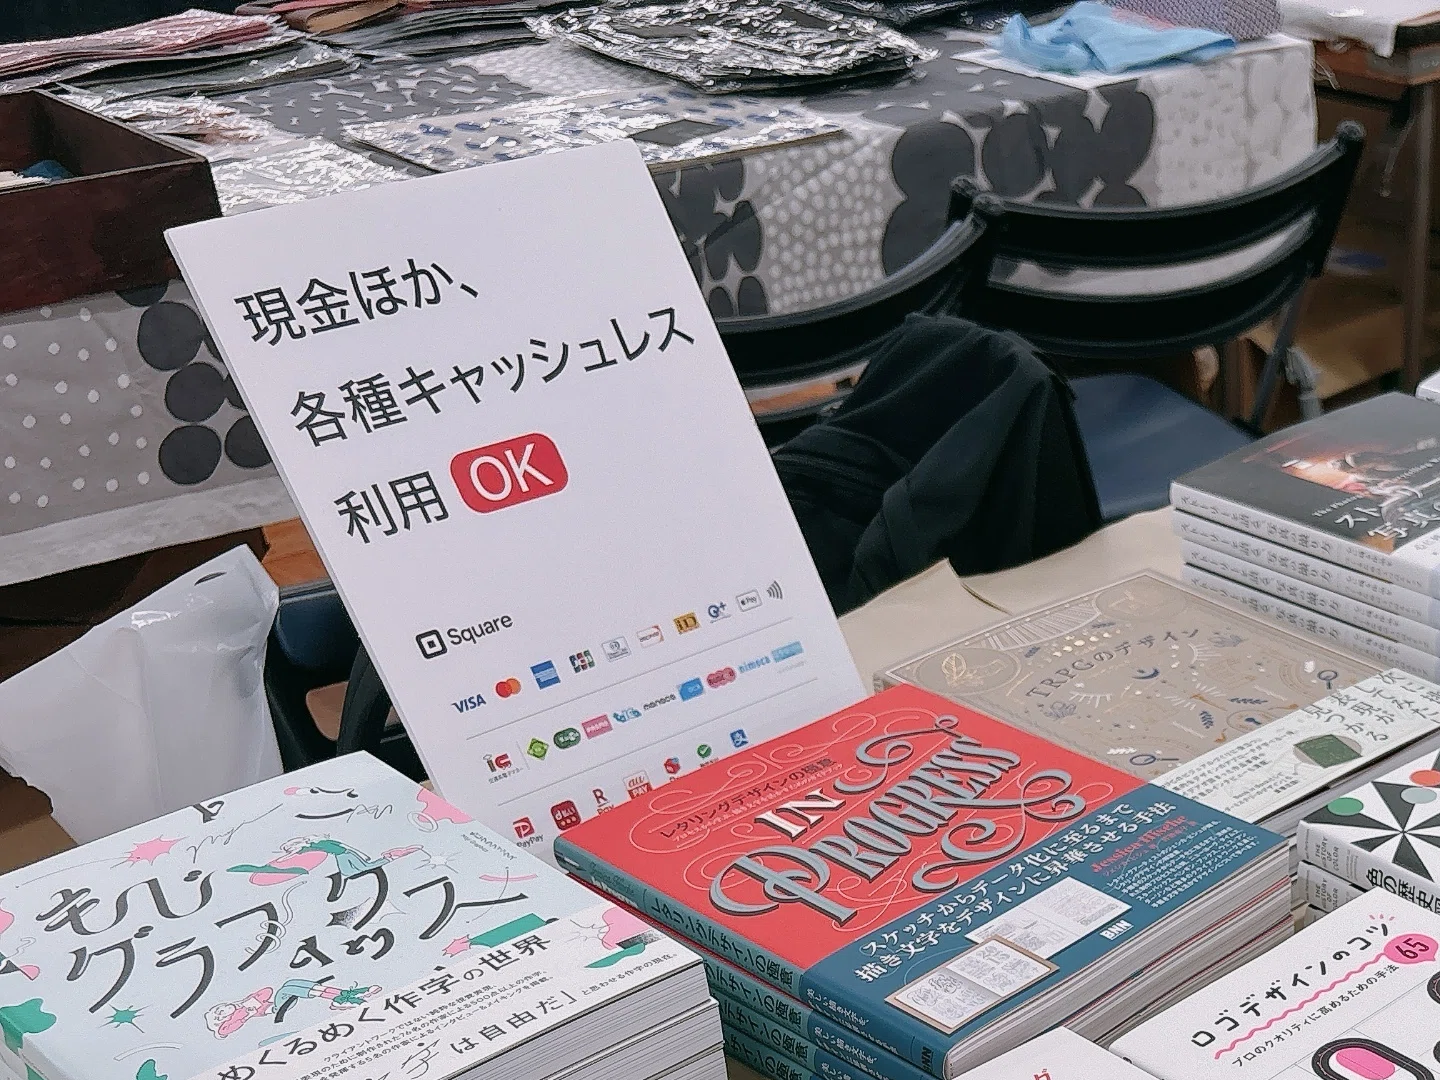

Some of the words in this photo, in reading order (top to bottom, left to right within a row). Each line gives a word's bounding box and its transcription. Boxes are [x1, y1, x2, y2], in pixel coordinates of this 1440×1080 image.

[234, 257, 480, 346] 現金ほか、
[289, 305, 695, 447] 各種キャッシュレス
[333, 470, 450, 545] 利用
[468, 443, 554, 503] OK
[447, 613, 514, 648] Square
[1025, 628, 1200, 699] TRPGのデザイン
[451, 693, 487, 714] VISA
[1302, 703, 1390, 742] 見つかる
[516, 834, 545, 850] PayPay
[709, 734, 1022, 926] PROGRESS
[754, 788, 847, 842] IN
[854, 802, 1178, 983] 描き文字をデザインに昇華させる手法
[863, 802, 1135, 957] スケッチからデータ化に至るまで
[1099, 919, 1136, 941] BNN
[1395, 937, 1431, 959] 65
[580, 953, 679, 997] と思わせる作字の現在。
[1191, 922, 1390, 1048] ロゴデザインのコツ
[1230, 963, 1399, 1069] プロのクオリティに高めるための手法
